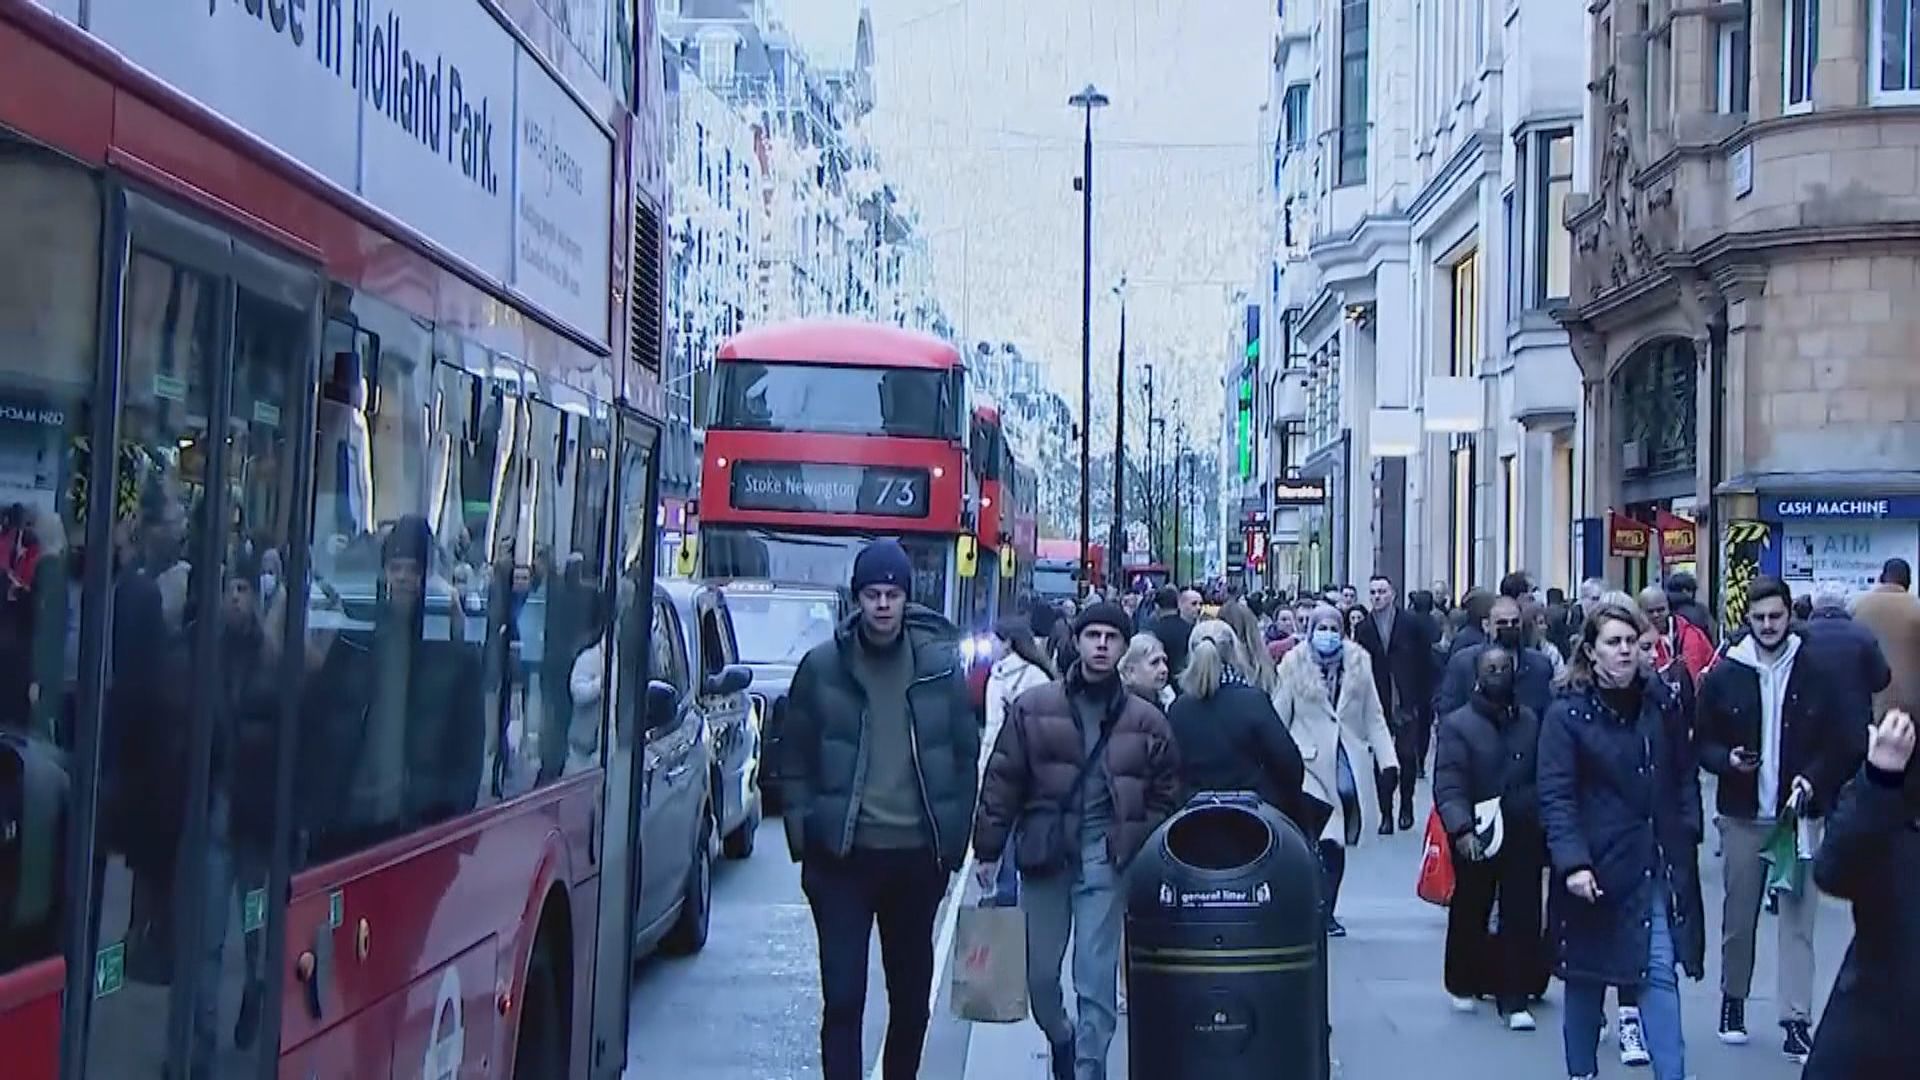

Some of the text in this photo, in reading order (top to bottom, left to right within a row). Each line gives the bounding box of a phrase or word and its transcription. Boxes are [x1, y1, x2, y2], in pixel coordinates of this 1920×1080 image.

[352, 0, 443, 154] Holland
[449, 64, 498, 197] Park.
[744, 470, 915, 506] Stoke Newington 73
[1778, 501, 1888, 515] CASH MACHINE
[1824, 535, 1871, 553] ATM
